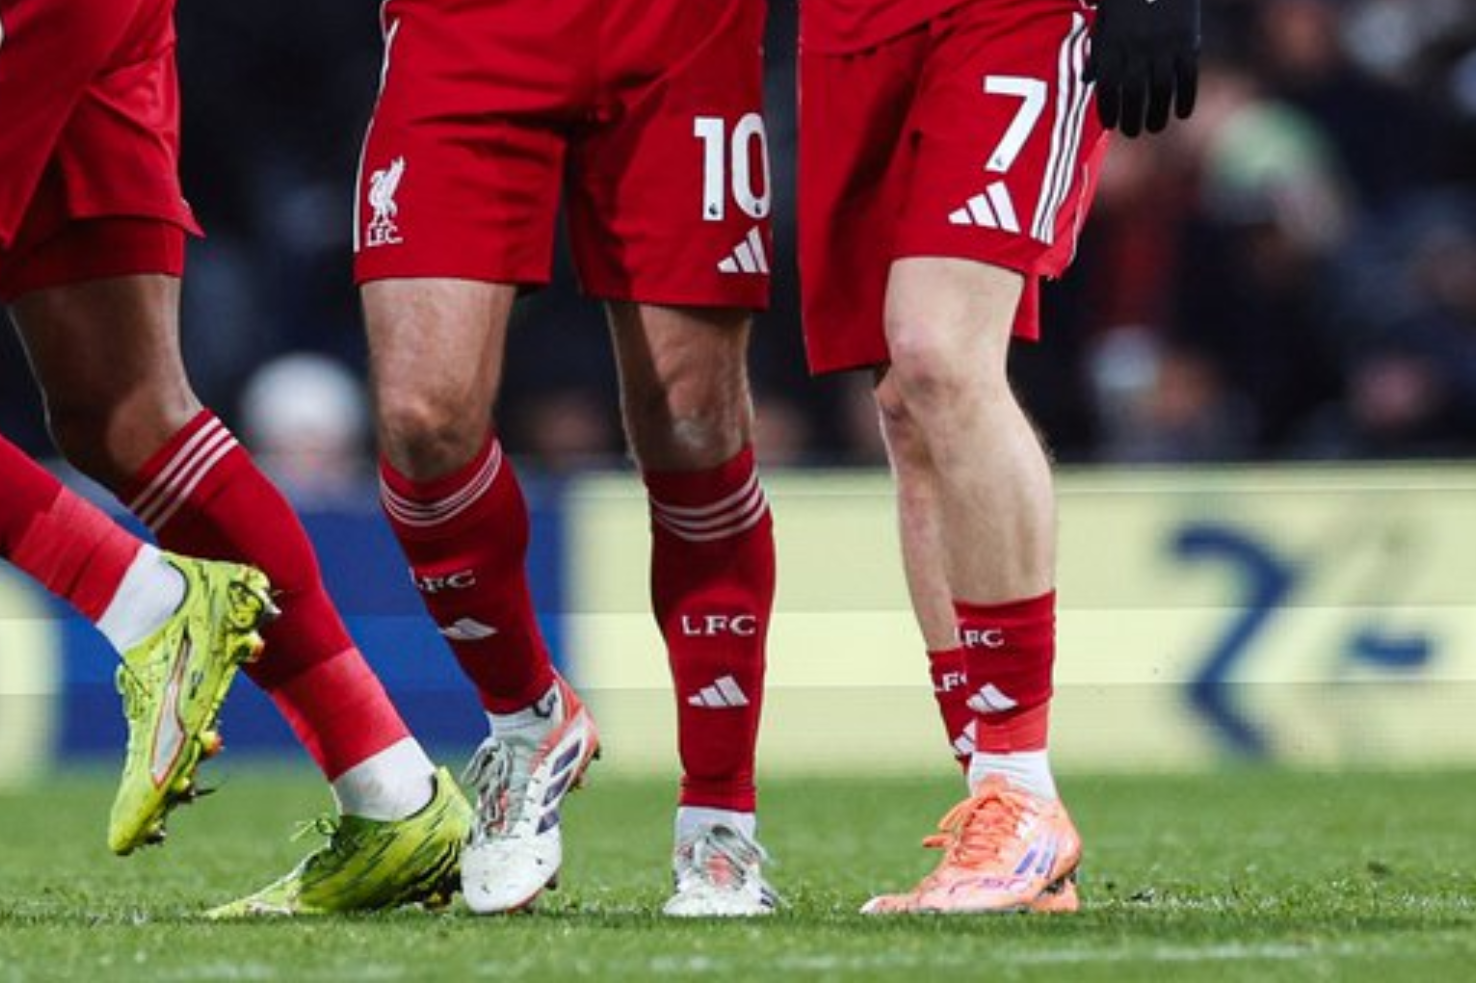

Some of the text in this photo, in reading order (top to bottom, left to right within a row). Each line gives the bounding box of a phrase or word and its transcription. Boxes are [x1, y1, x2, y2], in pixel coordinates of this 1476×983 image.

[694, 112, 771, 221] 10
[983, 75, 1048, 173] 7
[682, 615, 756, 636] LFC
